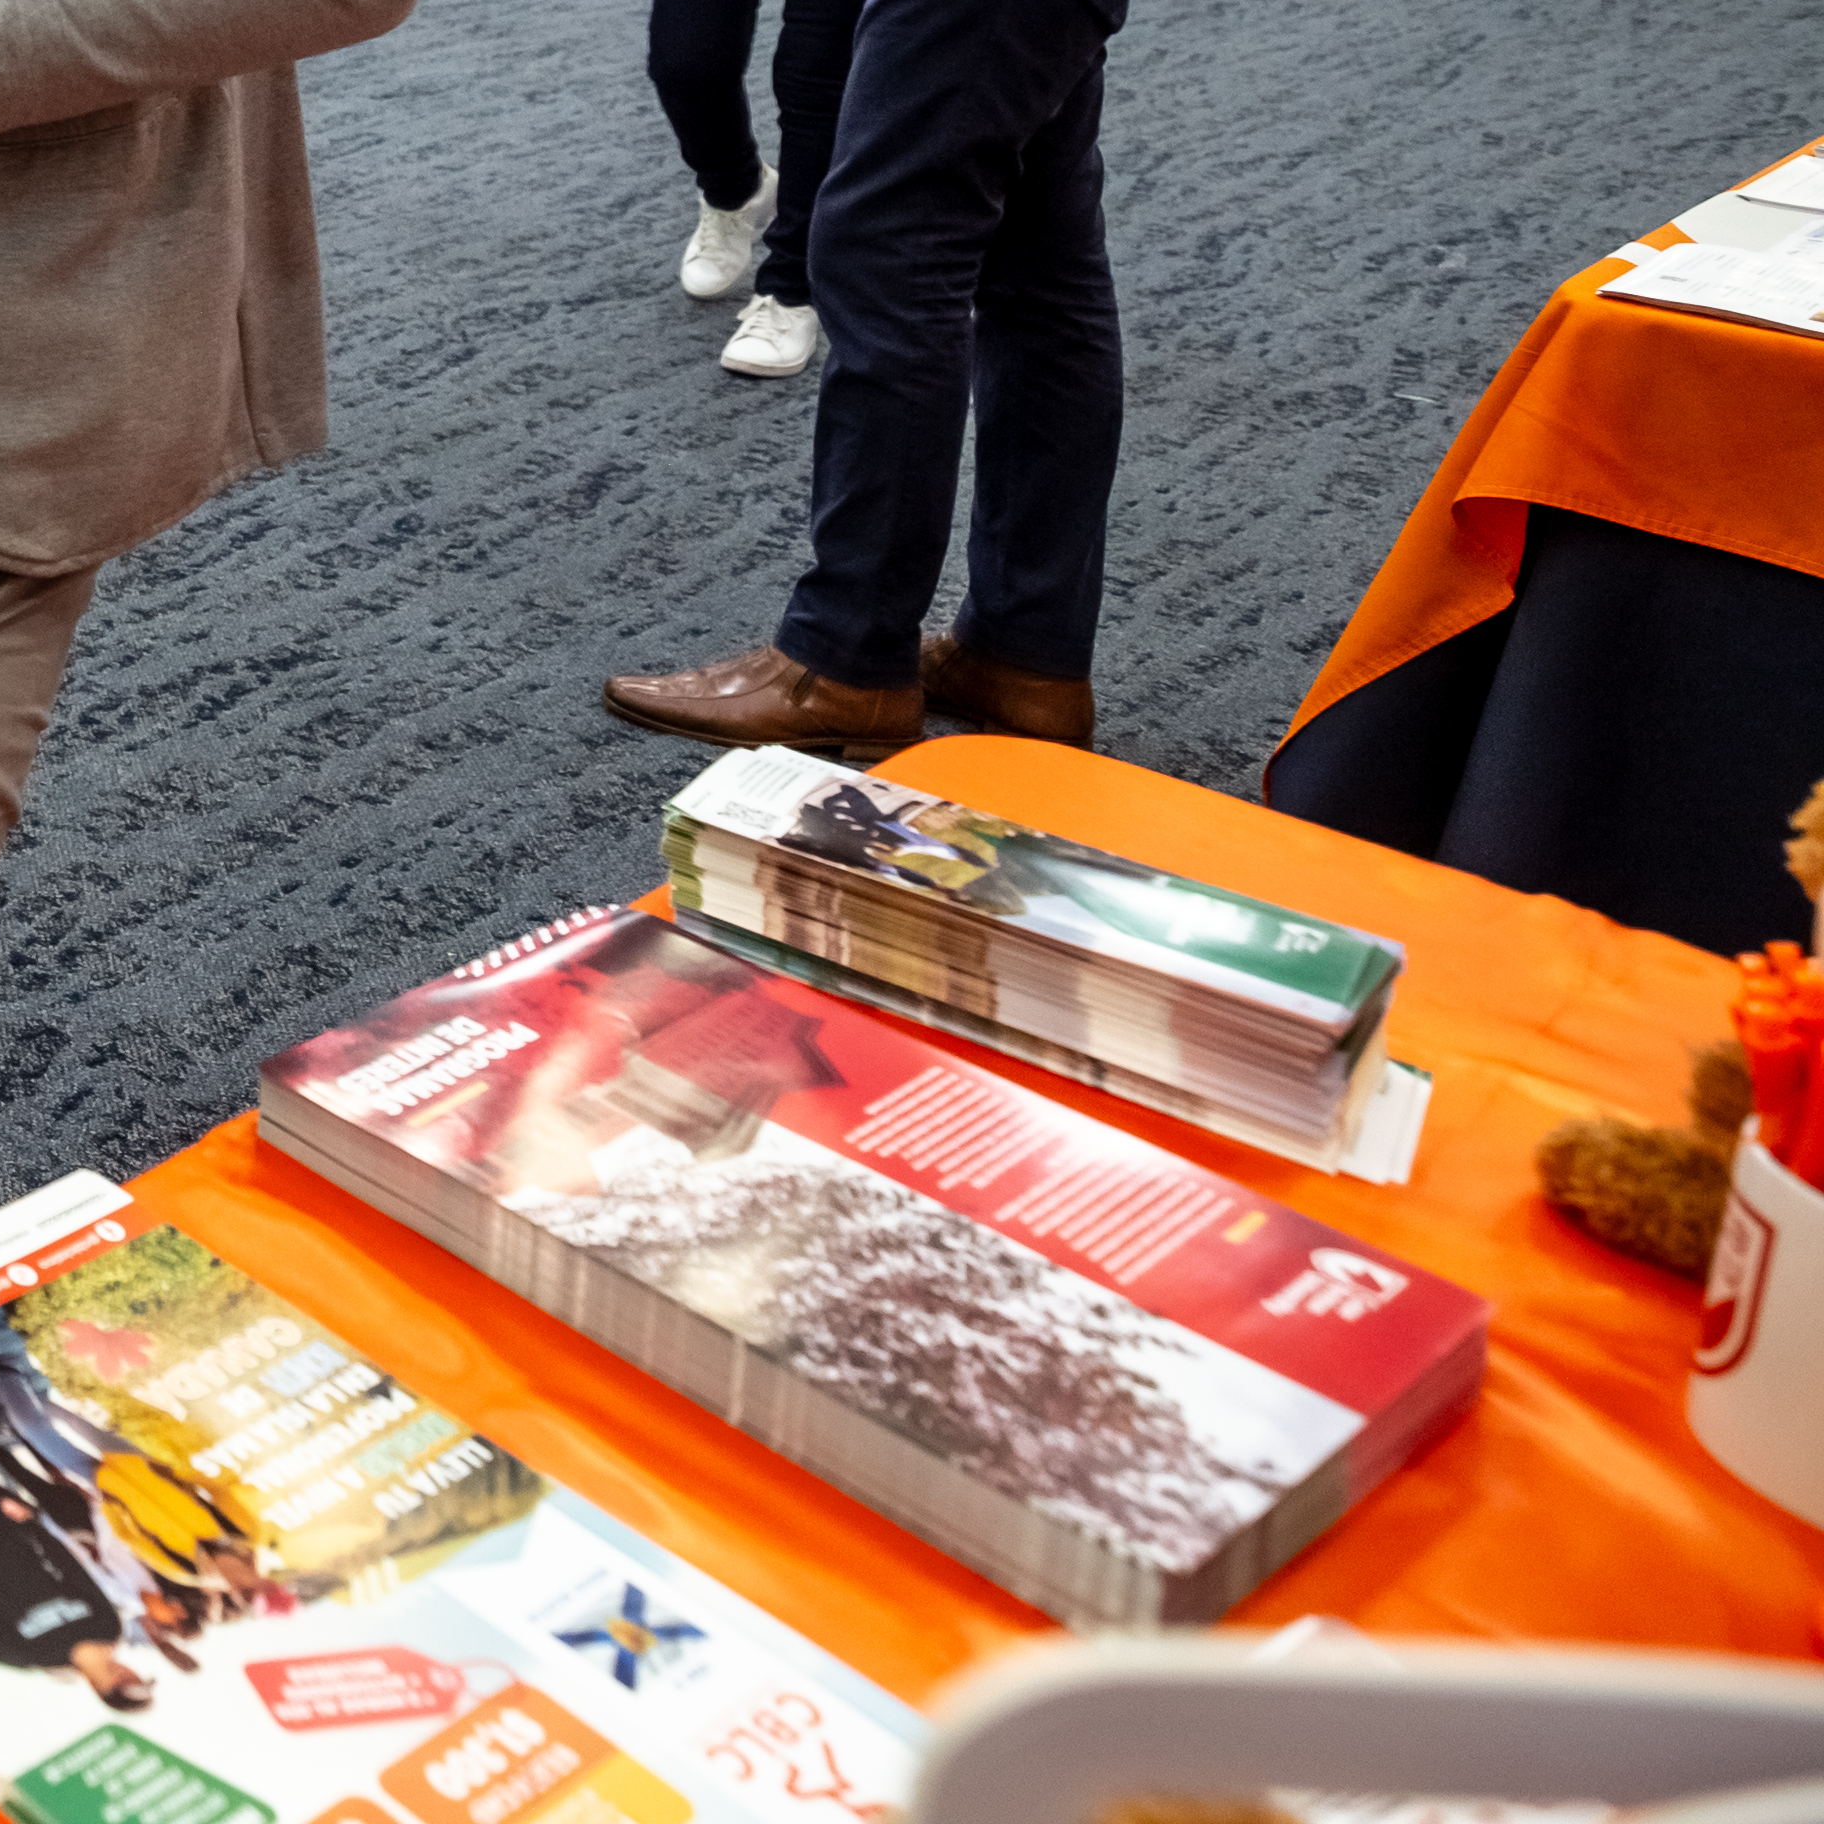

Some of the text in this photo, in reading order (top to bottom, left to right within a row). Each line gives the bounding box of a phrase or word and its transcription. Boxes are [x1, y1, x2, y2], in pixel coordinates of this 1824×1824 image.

[336, 1015, 488, 1094] DE INTERÉS
[370, 1021, 541, 1116] PROGRAMAS
[128, 1315, 303, 1423] CANADÁ
[301, 1378, 349, 1414] LA
[333, 1361, 382, 1397] EN
[372, 1438, 494, 1520] LLEVA TU
